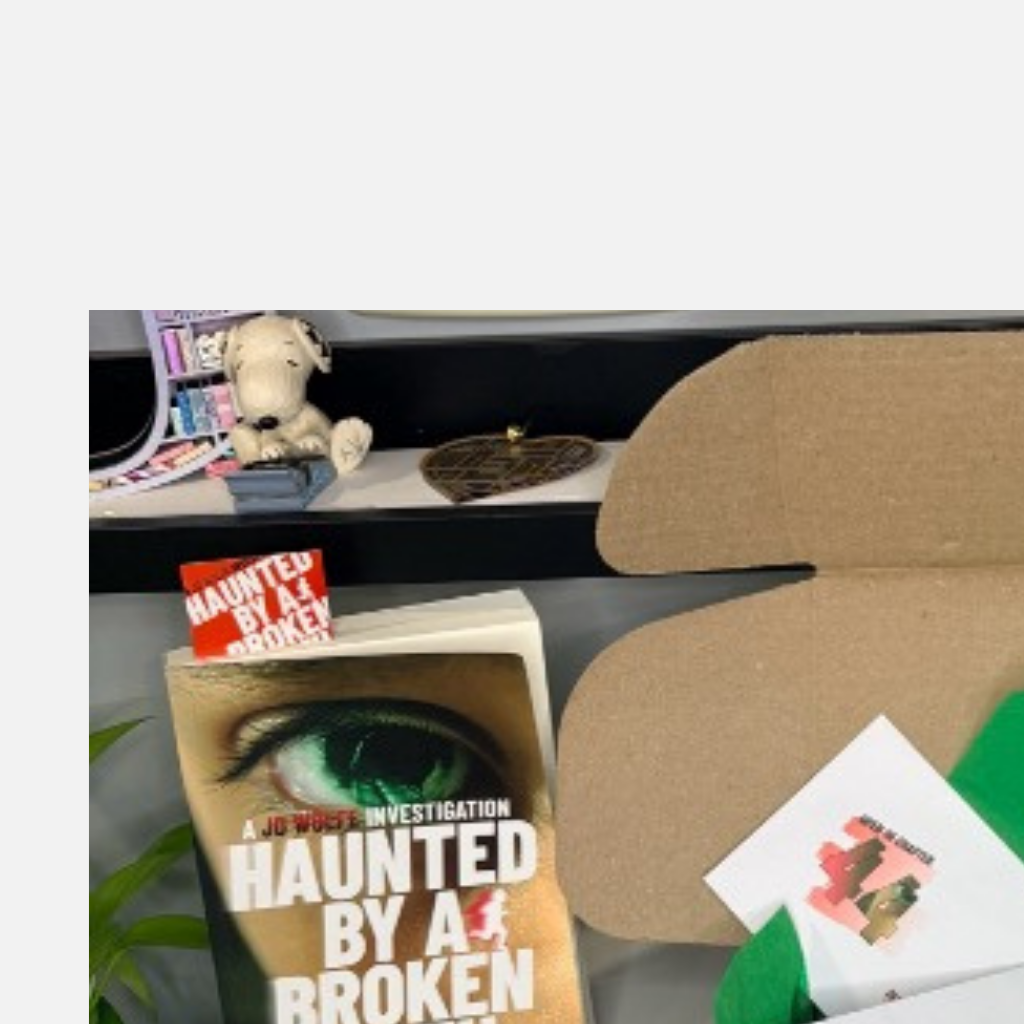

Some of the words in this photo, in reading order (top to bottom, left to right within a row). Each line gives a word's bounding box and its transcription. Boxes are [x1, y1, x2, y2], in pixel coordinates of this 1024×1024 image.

[186, 551, 314, 626] HAUNTED
[231, 594, 268, 636] BY
[276, 583, 301, 617] A
[242, 818, 257, 840] A
[364, 798, 511, 829] INVESTIGATION
[228, 818, 537, 912] HAUNTED
[323, 895, 405, 967] BY
[425, 888, 469, 955] A
